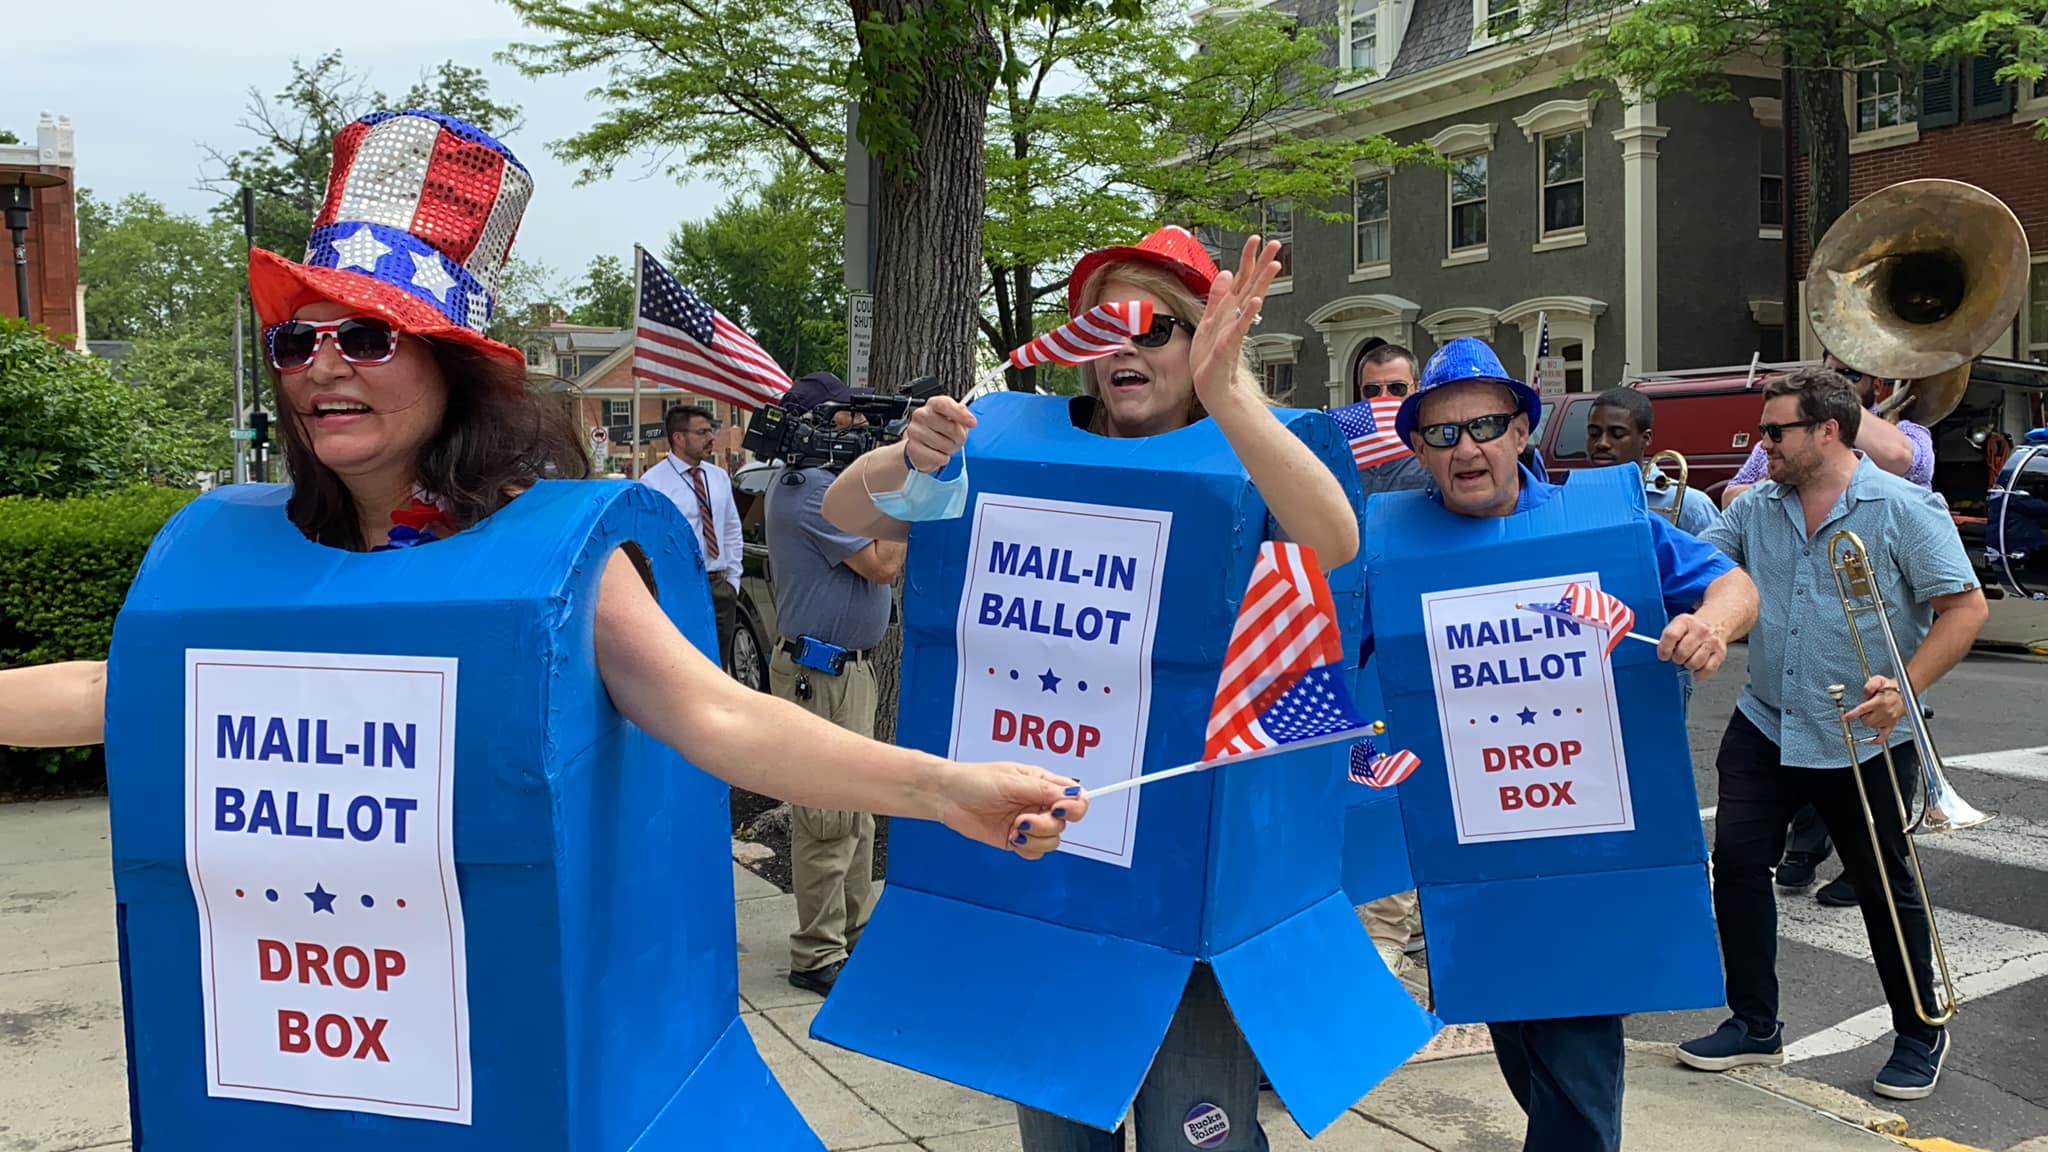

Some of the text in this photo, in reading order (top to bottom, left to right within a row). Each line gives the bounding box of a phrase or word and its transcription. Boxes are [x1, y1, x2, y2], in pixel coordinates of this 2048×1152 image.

[854, 315, 873, 328] SHUT
[856, 300, 872, 312] COU
[988, 541, 1137, 591] MAIL-IN
[978, 593, 1131, 645] BALLOT
[1445, 614, 1581, 650] MAIL-IN
[1451, 651, 1586, 689] BALLOT
[215, 714, 417, 769] MAIL-IN
[992, 708, 1101, 758] DROP
[1482, 740, 1582, 773] DROP
[214, 786, 418, 844] BALLOT
[1498, 781, 1576, 811] BOX
[257, 938, 406, 991] DROP
[277, 1008, 391, 1063] BOX
[1187, 1112, 1222, 1133] Bucks
[1192, 1121, 1226, 1141] Voices
